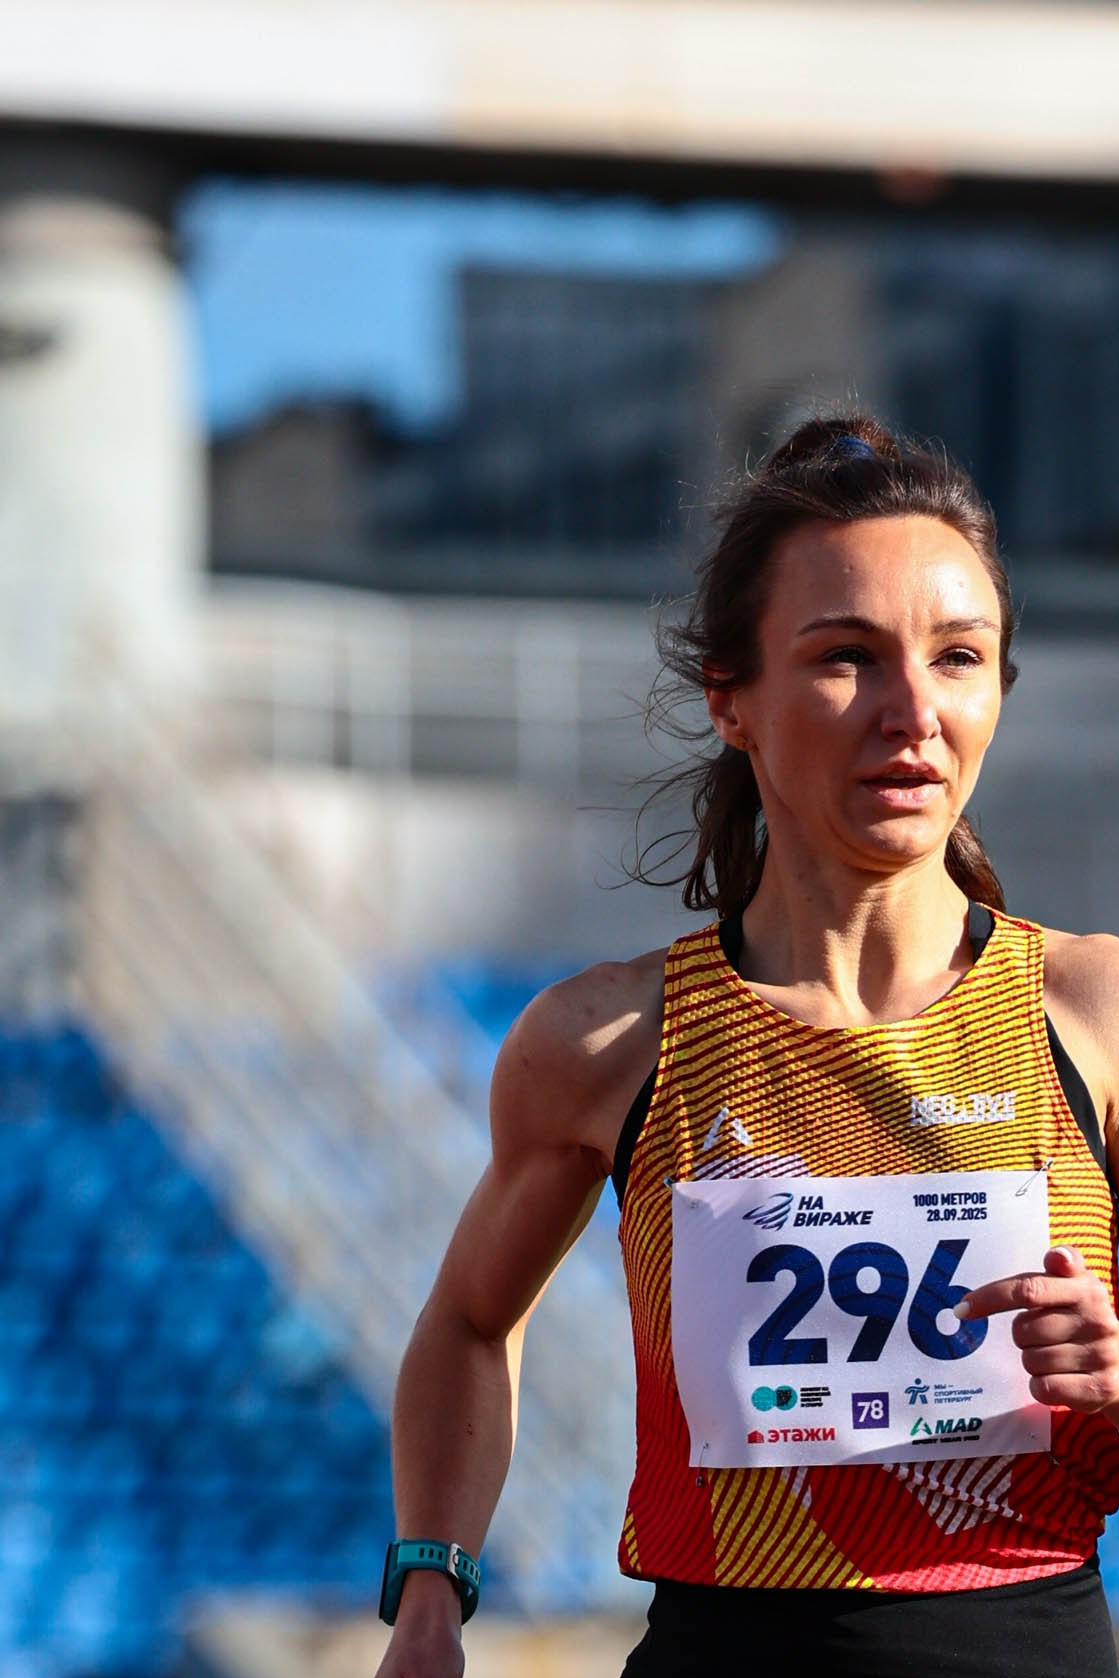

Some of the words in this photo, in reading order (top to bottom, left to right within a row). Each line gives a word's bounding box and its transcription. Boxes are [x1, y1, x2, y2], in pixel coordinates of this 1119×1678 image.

[798, 1195, 825, 1211] НА
[912, 1194, 939, 1207] 1000
[940, 1191, 988, 1206] МЕТРОВ
[792, 1210, 874, 1227] ВИРАЖЕ
[926, 1207, 988, 1222] 28.09.2025
[746, 1238, 989, 1367] 296
[857, 1399, 884, 1423] 78
[934, 1417, 983, 1434] MAD
